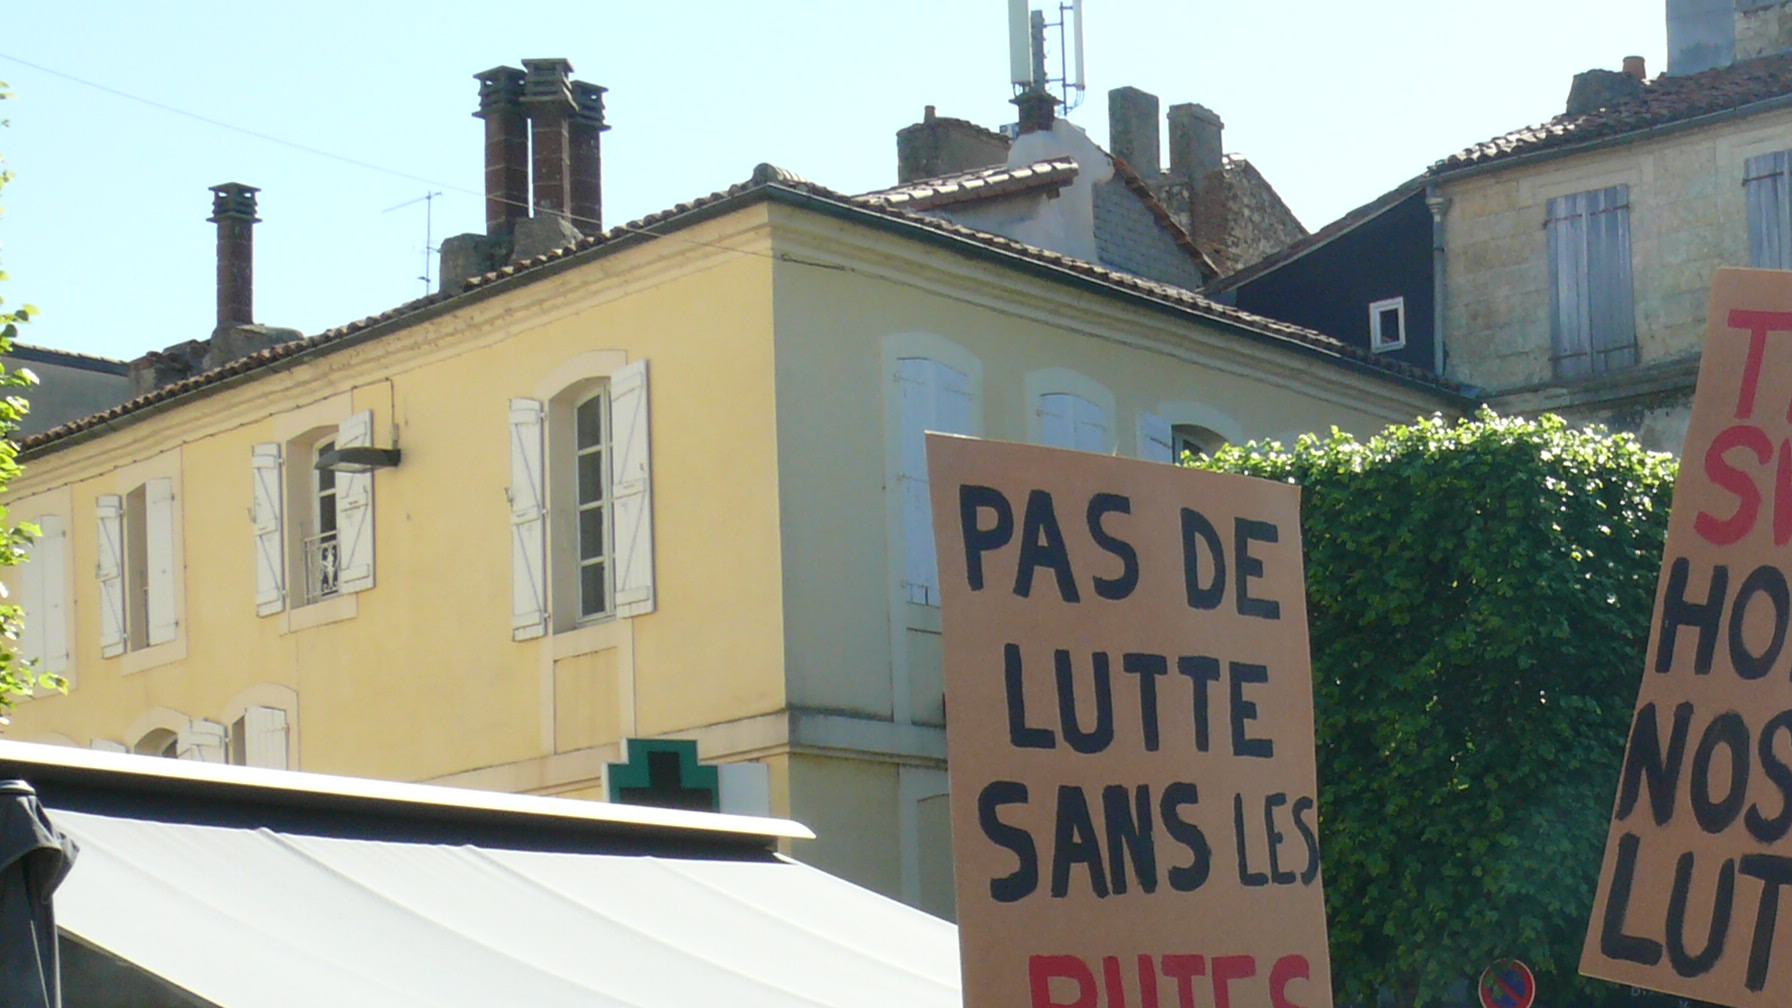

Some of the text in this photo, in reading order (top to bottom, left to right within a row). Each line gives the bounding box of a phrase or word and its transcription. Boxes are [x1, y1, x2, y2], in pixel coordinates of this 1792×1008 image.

[959, 484, 1281, 620] PAS DE
[1004, 642, 1274, 759] LUTTE
[978, 780, 1321, 902] SANS LES
